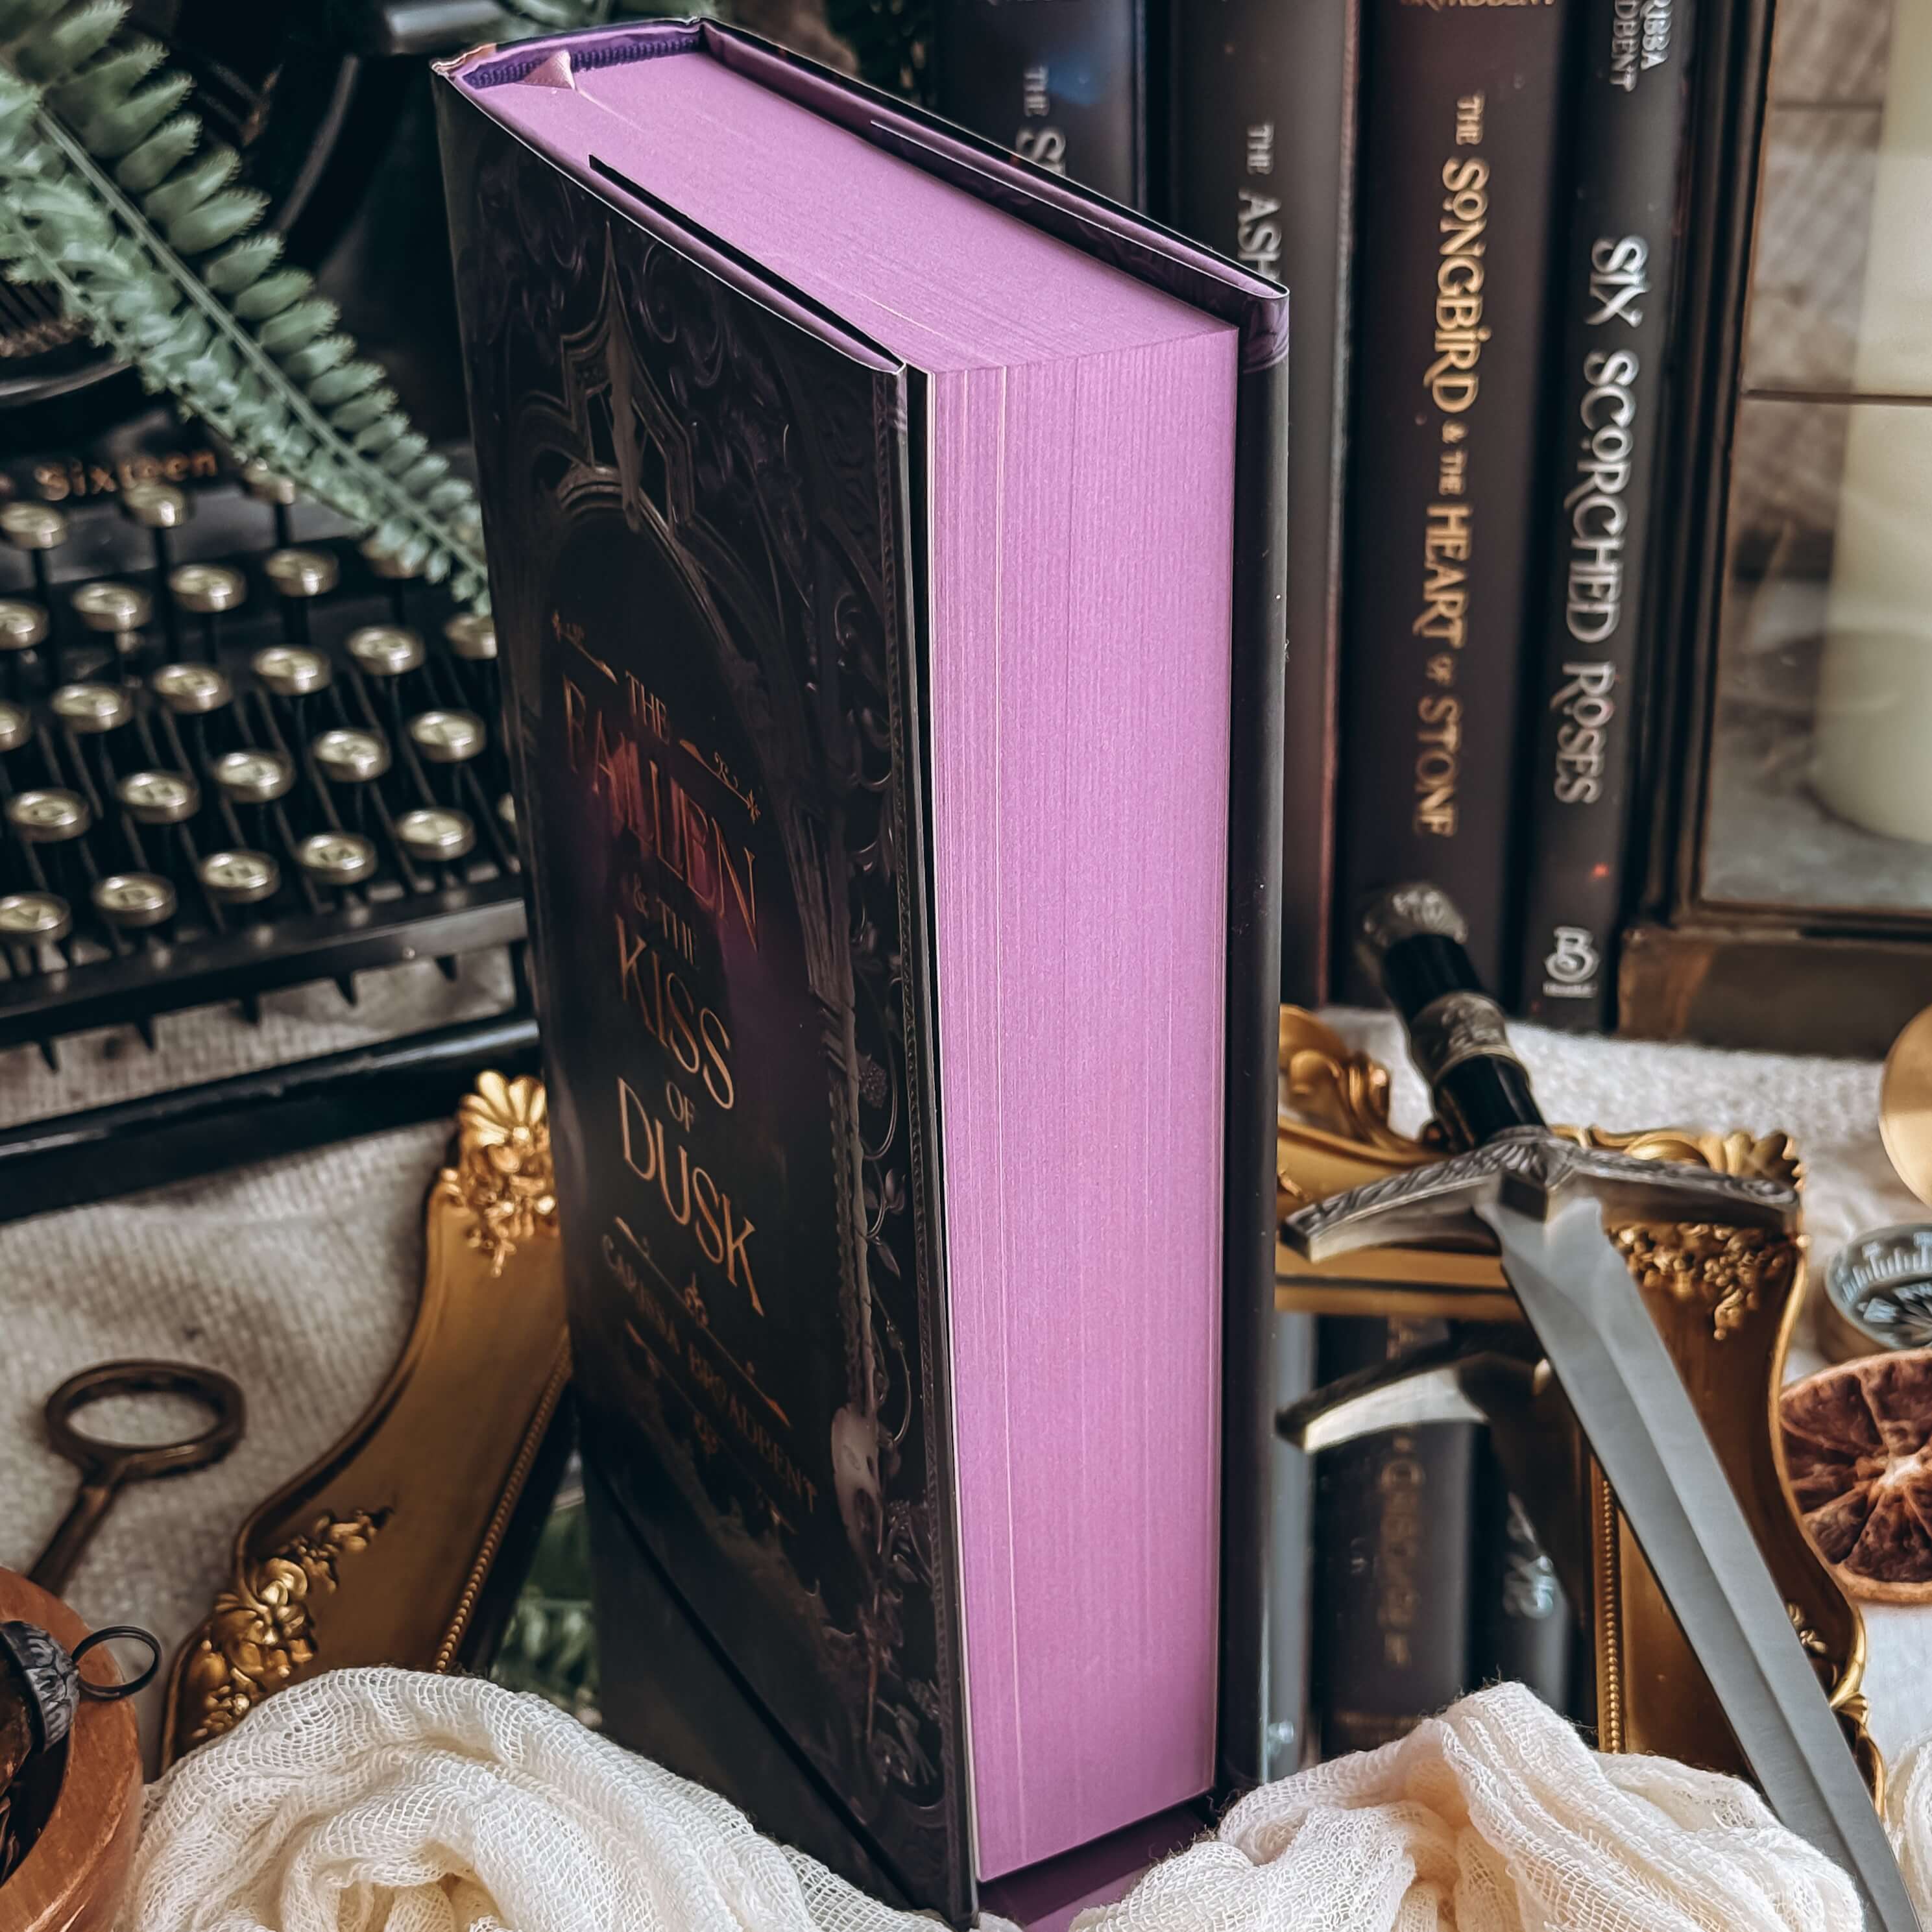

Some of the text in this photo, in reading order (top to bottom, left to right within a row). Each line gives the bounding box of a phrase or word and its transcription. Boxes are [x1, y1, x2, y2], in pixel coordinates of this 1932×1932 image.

[1016, 127, 1066, 176] S
[1246, 123, 1275, 175] THE
[1455, 90, 1486, 146] THE
[1423, 156, 1491, 413] SONGBIRD
[1412, 502, 1473, 649] HEART
[1551, 235, 1650, 804] SIX SCORCHED ROSES
[625, 670, 670, 745] THE
[1413, 694, 1462, 837] STONE
[614, 913, 735, 1110] KISS
[665, 1081, 695, 1133] OF
[617, 1076, 765, 1318] DUSK
